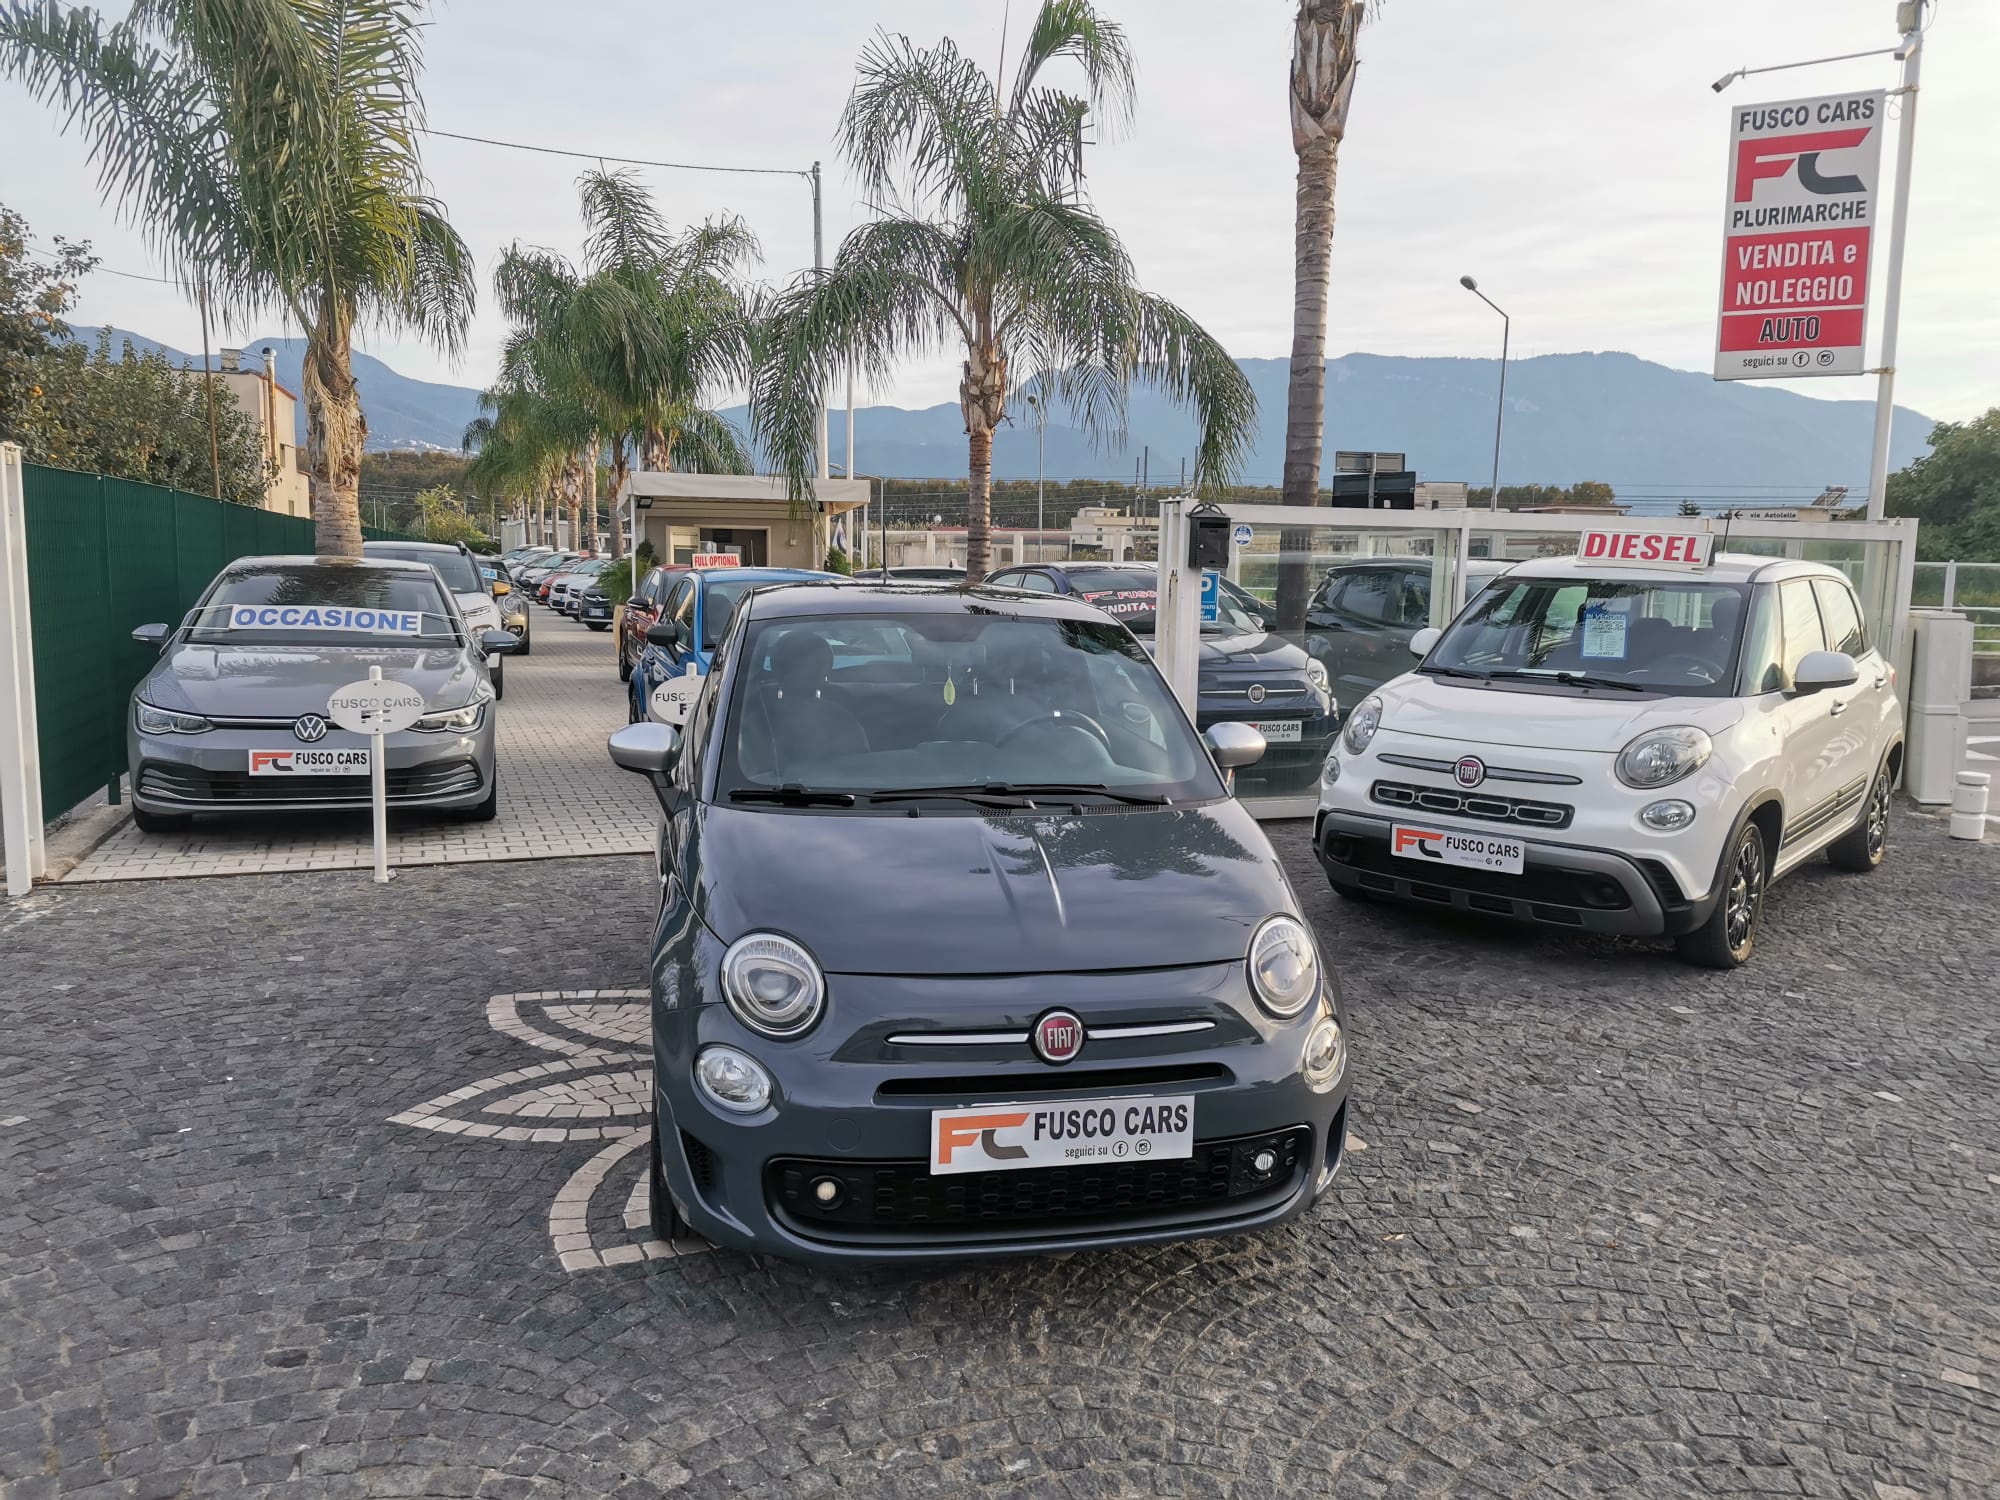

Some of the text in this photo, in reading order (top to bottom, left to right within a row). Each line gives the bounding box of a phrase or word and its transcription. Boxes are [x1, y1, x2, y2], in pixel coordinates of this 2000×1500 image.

[1739, 98, 1875, 132] FUSCO CARS
[1733, 200, 1868, 229] PLURIMARCHE
[1738, 240, 1857, 270] VENDITA e
[1736, 275, 1853, 306] NOLEGGIO
[1759, 315, 1821, 343] AUTO
[1743, 355, 1788, 369] seguici su
[1584, 533, 1701, 563] DIESEL
[694, 555, 739, 567] FULL OPTIONAL
[1098, 602, 1149, 614] ENDITA
[234, 608, 418, 632] OCCASIONE
[332, 697, 421, 709] FUSCO CARS
[1259, 723, 1281, 732] FUSCO
[1282, 723, 1300, 732] CARS
[295, 752, 368, 765] FUSCO CARS
[1460, 765, 1478, 780] FIAT
[1446, 836, 1520, 859] FUSCO CARS
[1047, 1026, 1073, 1049] FIAT
[1033, 1104, 1188, 1141] FUSCO CARS
[1064, 1145, 1108, 1159] seguici su
